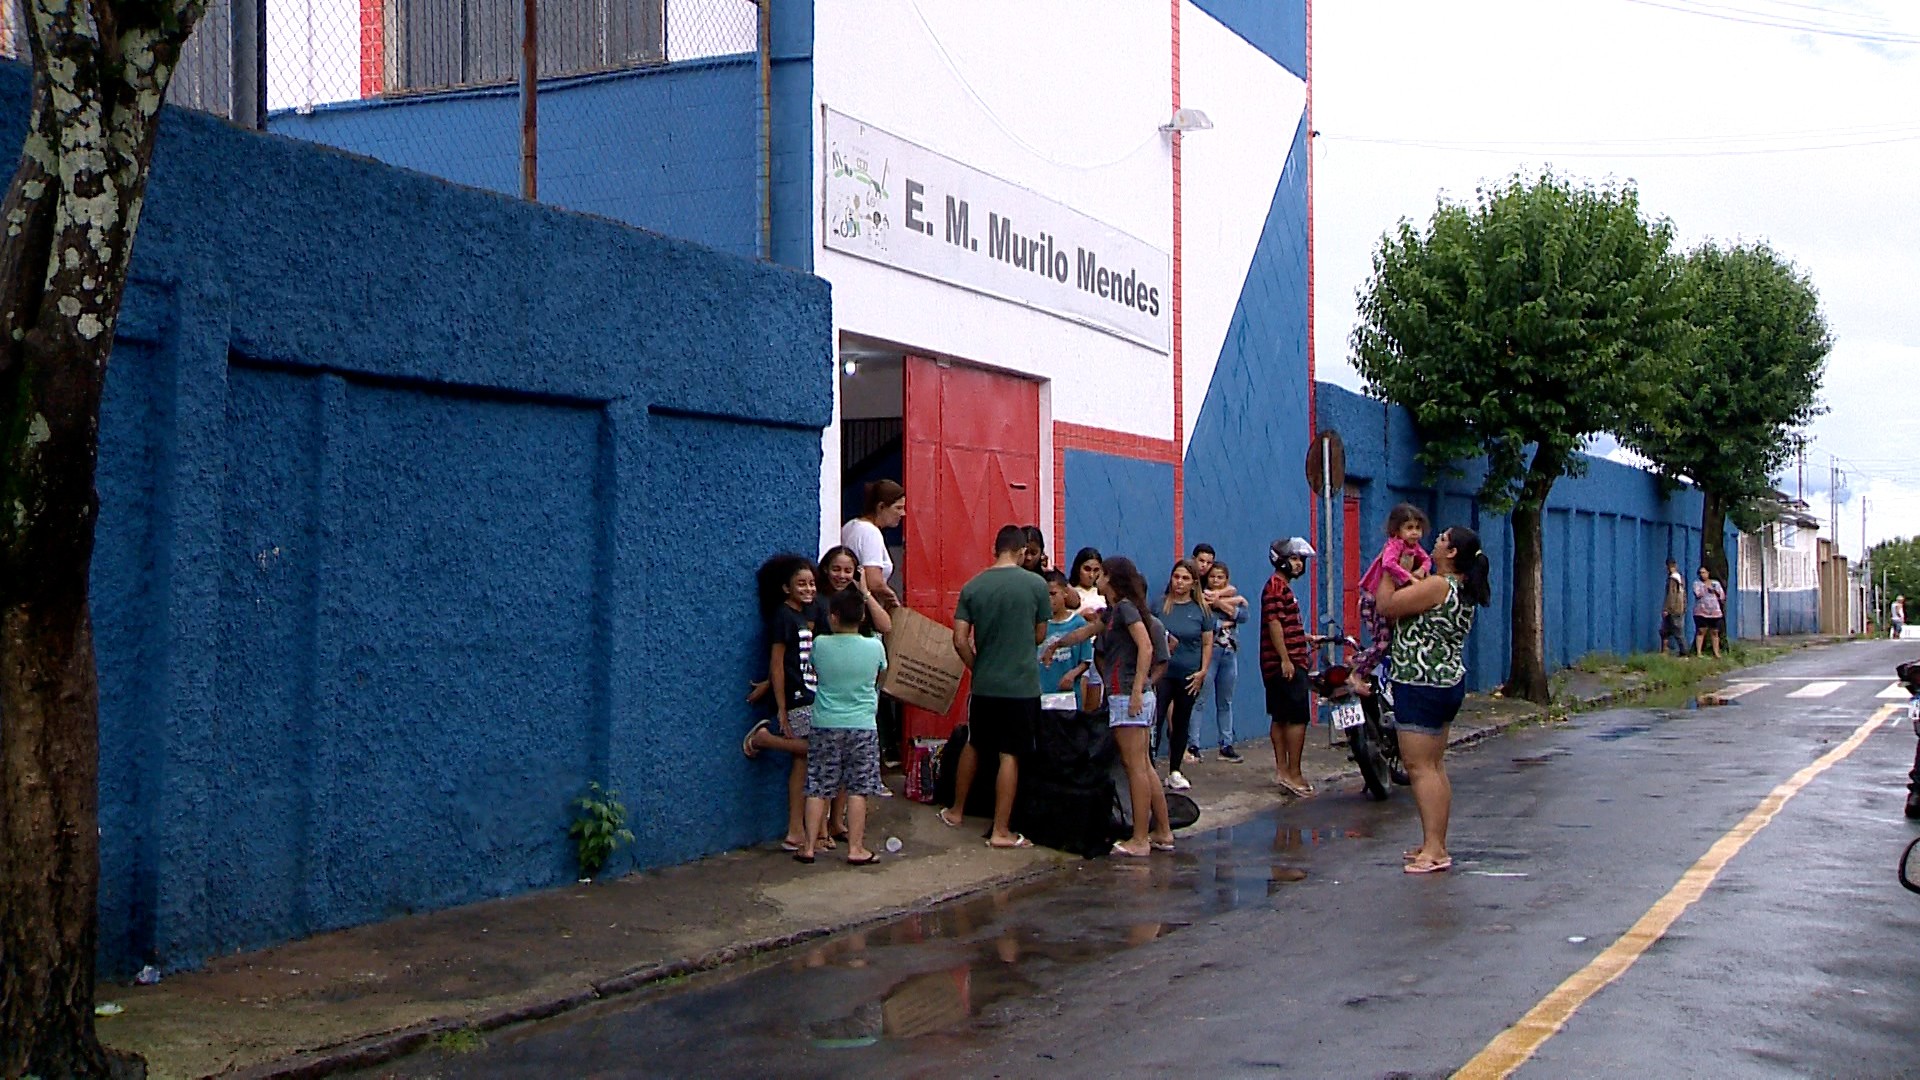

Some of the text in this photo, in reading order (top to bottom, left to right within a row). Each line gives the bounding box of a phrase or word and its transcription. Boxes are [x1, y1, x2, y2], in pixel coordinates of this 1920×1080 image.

[905, 178, 934, 236] E.
[945, 195, 978, 252] M.
[988, 212, 1068, 283] Murilo
[1077, 247, 1160, 317] Mendes
